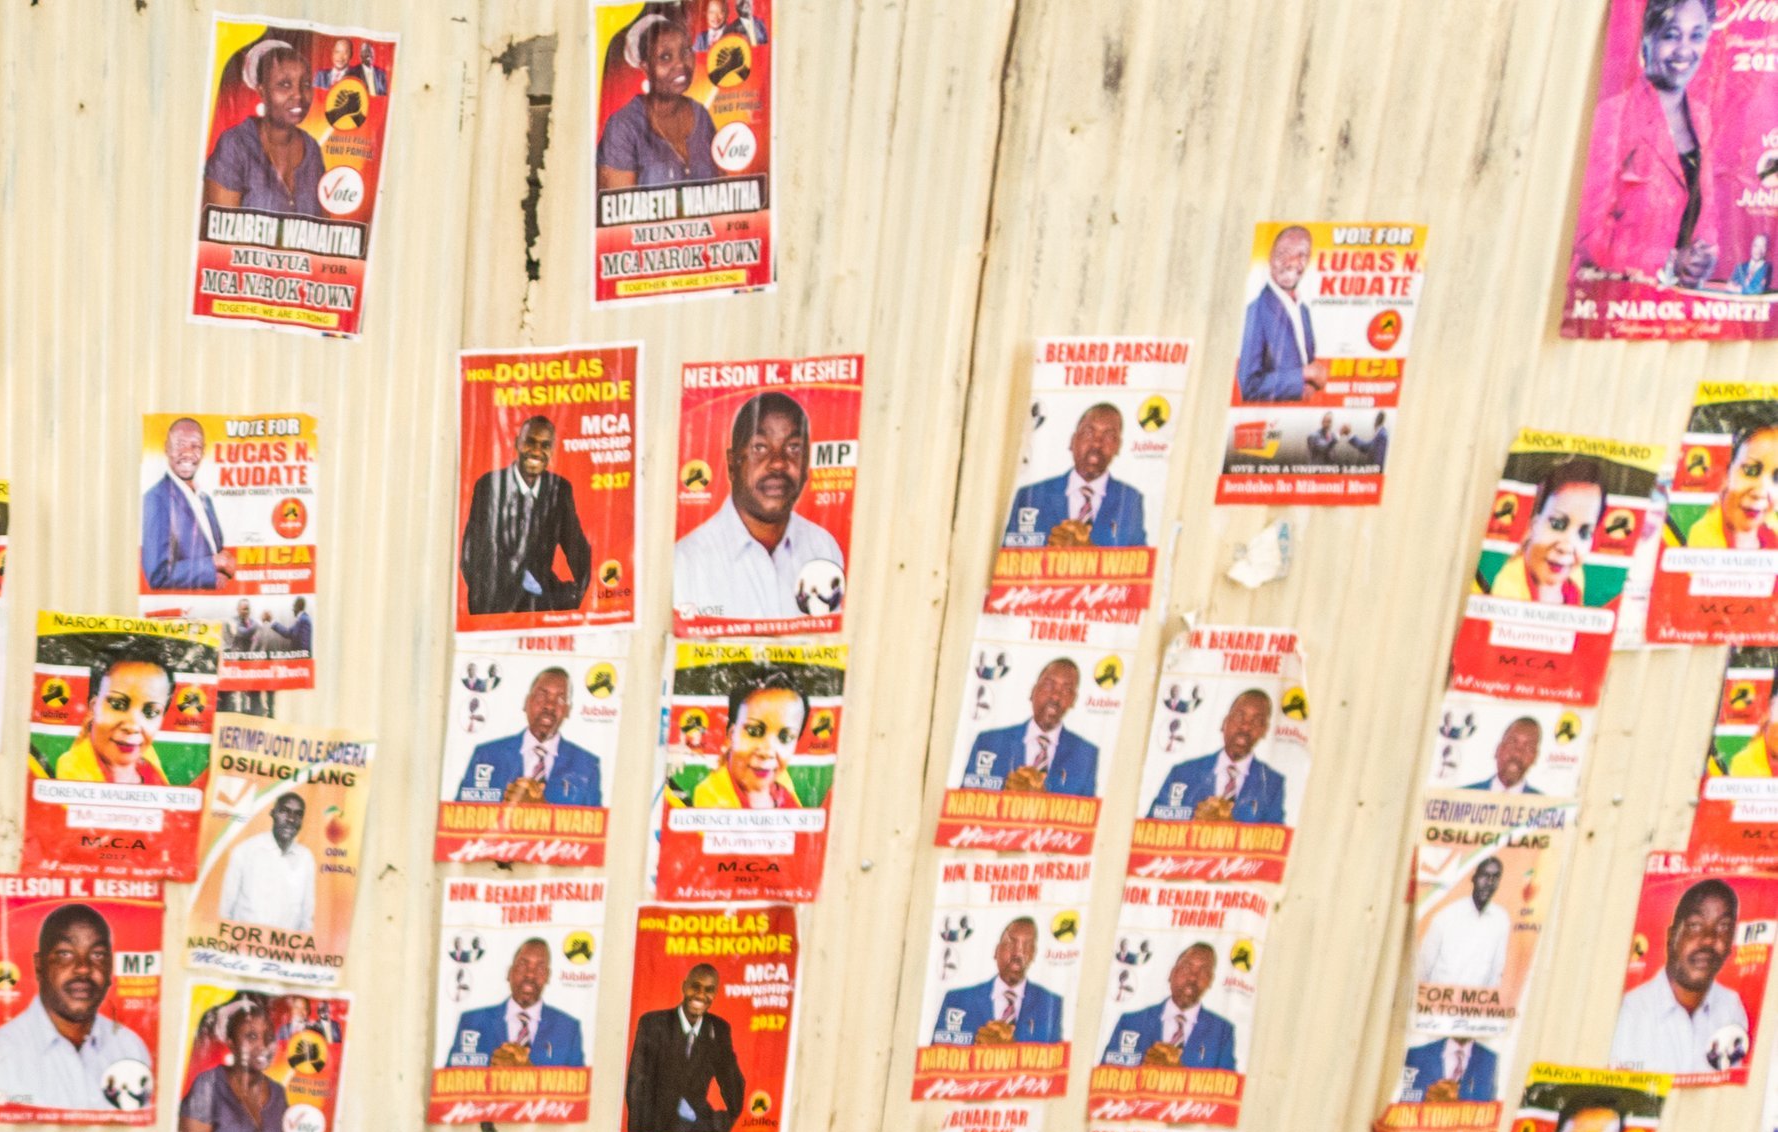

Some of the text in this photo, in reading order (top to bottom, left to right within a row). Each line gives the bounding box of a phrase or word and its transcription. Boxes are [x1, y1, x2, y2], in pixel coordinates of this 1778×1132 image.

[601, 180, 762, 226] ELIZABETH WAMAITHA
[633, 221, 750, 245] MUNYUA FOR
[1333, 227, 1414, 246] VOTE FOR
[233, 248, 348, 276] MUNYUA FOR
[1318, 251, 1423, 274] LUCAS N.
[1046, 342, 1189, 365] BENARD PARSALOI
[683, 358, 858, 390] NELSON K. KESHEI
[1064, 365, 1128, 387] TOROME
[1329, 357, 1399, 379] MCA
[494, 380, 633, 407] MASIKONDE
[225, 418, 300, 438] VOTE FOR
[581, 413, 632, 436] MCA
[214, 441, 315, 464] LUCAS N.
[562, 437, 632, 453] TOWNSHIP
[815, 446, 852, 467] MP
[590, 472, 633, 491] 2017
[815, 491, 847, 506] 2017
[236, 545, 312, 565] MCA
[1047, 551, 1150, 578] TOWN WARD
[697, 605, 725, 617] VOTE
[1030, 621, 1089, 643] TOROME
[1208, 631, 1265, 651] BENARD
[1223, 653, 1282, 675] TOROME
[579, 704, 618, 717] Jubilee
[219, 754, 356, 787] OSILIGI LANG
[442, 805, 605, 835] NAROK TOWN WARD
[1425, 799, 1524, 828] KERIMPUOTI OLE
[81, 835, 147, 851] M.C.A
[1425, 825, 1551, 849] OSILIGI LANG
[321, 862, 357, 877] (NASA)
[717, 861, 780, 874] M.C.A
[70, 878, 89, 897] K.
[93, 877, 158, 897] KESHEI
[668, 913, 770, 934] DOUGLAS
[219, 922, 316, 950] FOR MCA
[665, 933, 793, 956] MASIKONDE
[187, 936, 344, 968] NAROK TOWN WARD
[123, 954, 155, 974] MP
[259, 960, 336, 983] Pamoja
[744, 963, 790, 983] MCA
[949, 1108, 1002, 1128] BENARD
